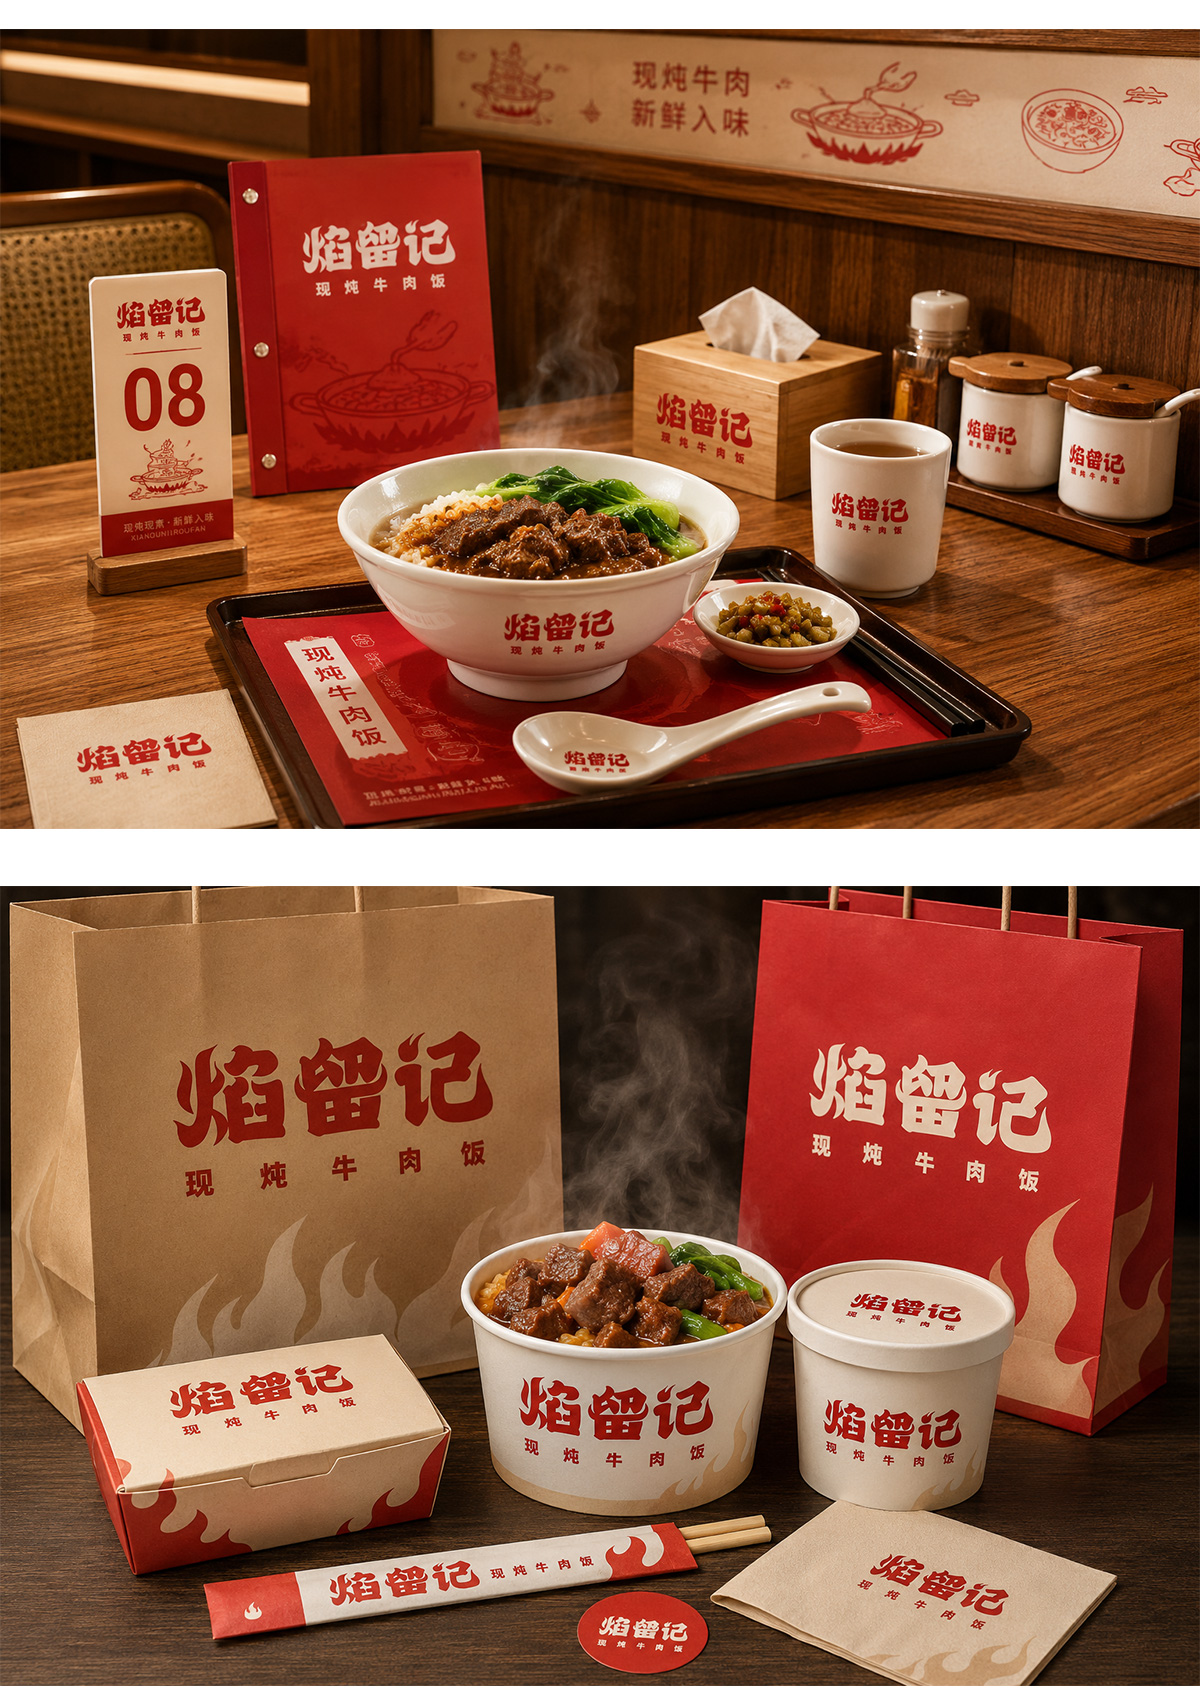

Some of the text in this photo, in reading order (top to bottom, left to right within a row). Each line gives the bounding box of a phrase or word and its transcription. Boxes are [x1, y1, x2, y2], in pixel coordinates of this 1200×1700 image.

[633, 61, 749, 97] 现炖牛肉
[632, 98, 748, 136] 新鲜入味
[303, 219, 455, 273] 焰留记
[316, 274, 445, 296] 现炖牛肉饭
[117, 297, 205, 329] 焰留记
[123, 328, 199, 342] 现炖牛肉饭
[125, 363, 205, 431] 08
[656, 392, 753, 447] 焰留记
[968, 419, 1017, 448] 焰留记
[661, 432, 745, 464] 现炖牛肉饭
[1070, 445, 1125, 477] 焰留记
[831, 492, 909, 523] 焰留记
[504, 610, 614, 641] 焰留记
[511, 641, 605, 655] 现炖牛肉饭
[302, 646, 387, 748] 现炖牛肉饭
[77, 732, 211, 776] 焰留记
[84, 753, 206, 784] 现炖牛肉饭
[564, 751, 629, 767] 焰留记
[173, 1031, 493, 1148] 焰留记
[809, 1043, 1051, 1153] 焰留记
[185, 1140, 485, 1197] 现炖牛肉饭
[812, 1134, 1039, 1192] 现炖牛肉饭
[846, 1310, 956, 1332] 现炖牛肉饭
[849, 1294, 961, 1324] 焰留记
[170, 1365, 353, 1420] 焰留记
[519, 1377, 713, 1440] 焰留记
[177, 1393, 356, 1435] 现炖牛肉饭
[824, 1400, 962, 1450] 焰留记
[525, 1438, 704, 1467] 现炖牛肉饭
[826, 1441, 954, 1467] 现炖牛肉饭
[330, 1561, 480, 1605] 焰留记
[490, 1556, 594, 1579] 现炖牛肉饭
[870, 1554, 1008, 1615] 焰留记
[858, 1580, 986, 1630] 现炖牛肉饭
[597, 1639, 682, 1652] 现炖牛肉饭
[599, 1616, 687, 1641] 焰留记
